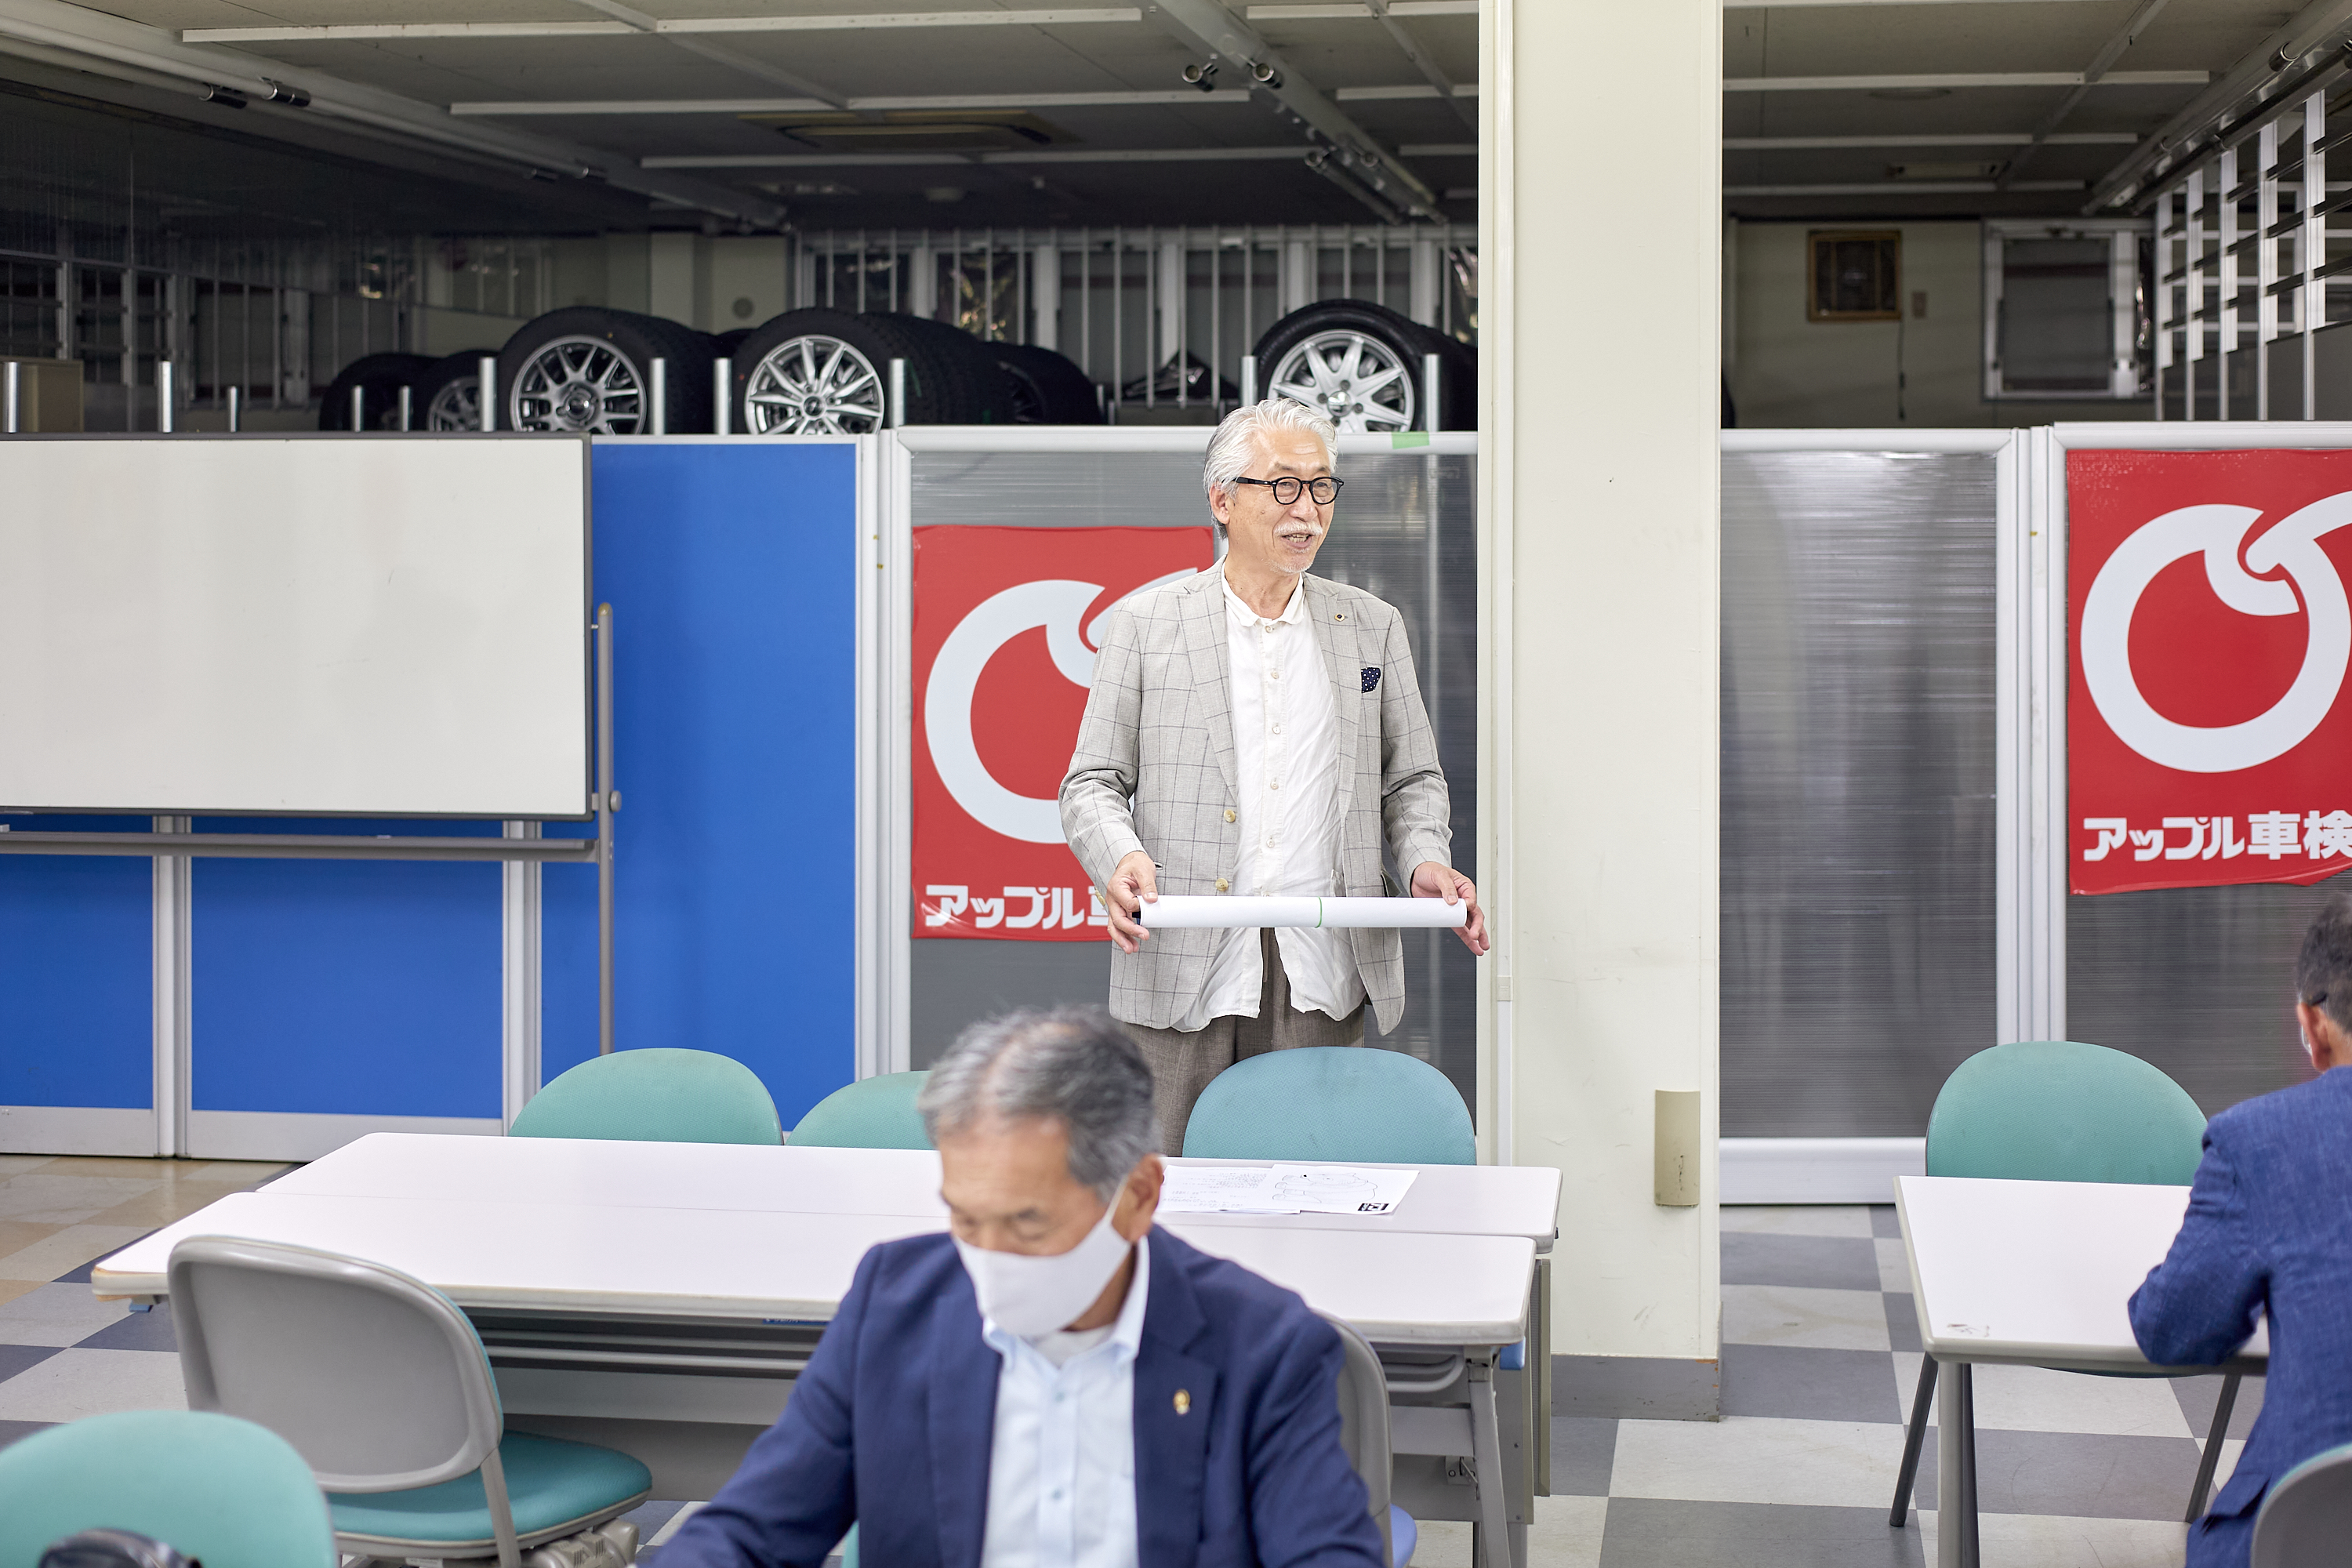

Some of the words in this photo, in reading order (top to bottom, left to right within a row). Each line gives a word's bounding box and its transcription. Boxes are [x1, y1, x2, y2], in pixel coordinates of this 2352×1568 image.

[2083, 810, 2352, 862] アップル車検
